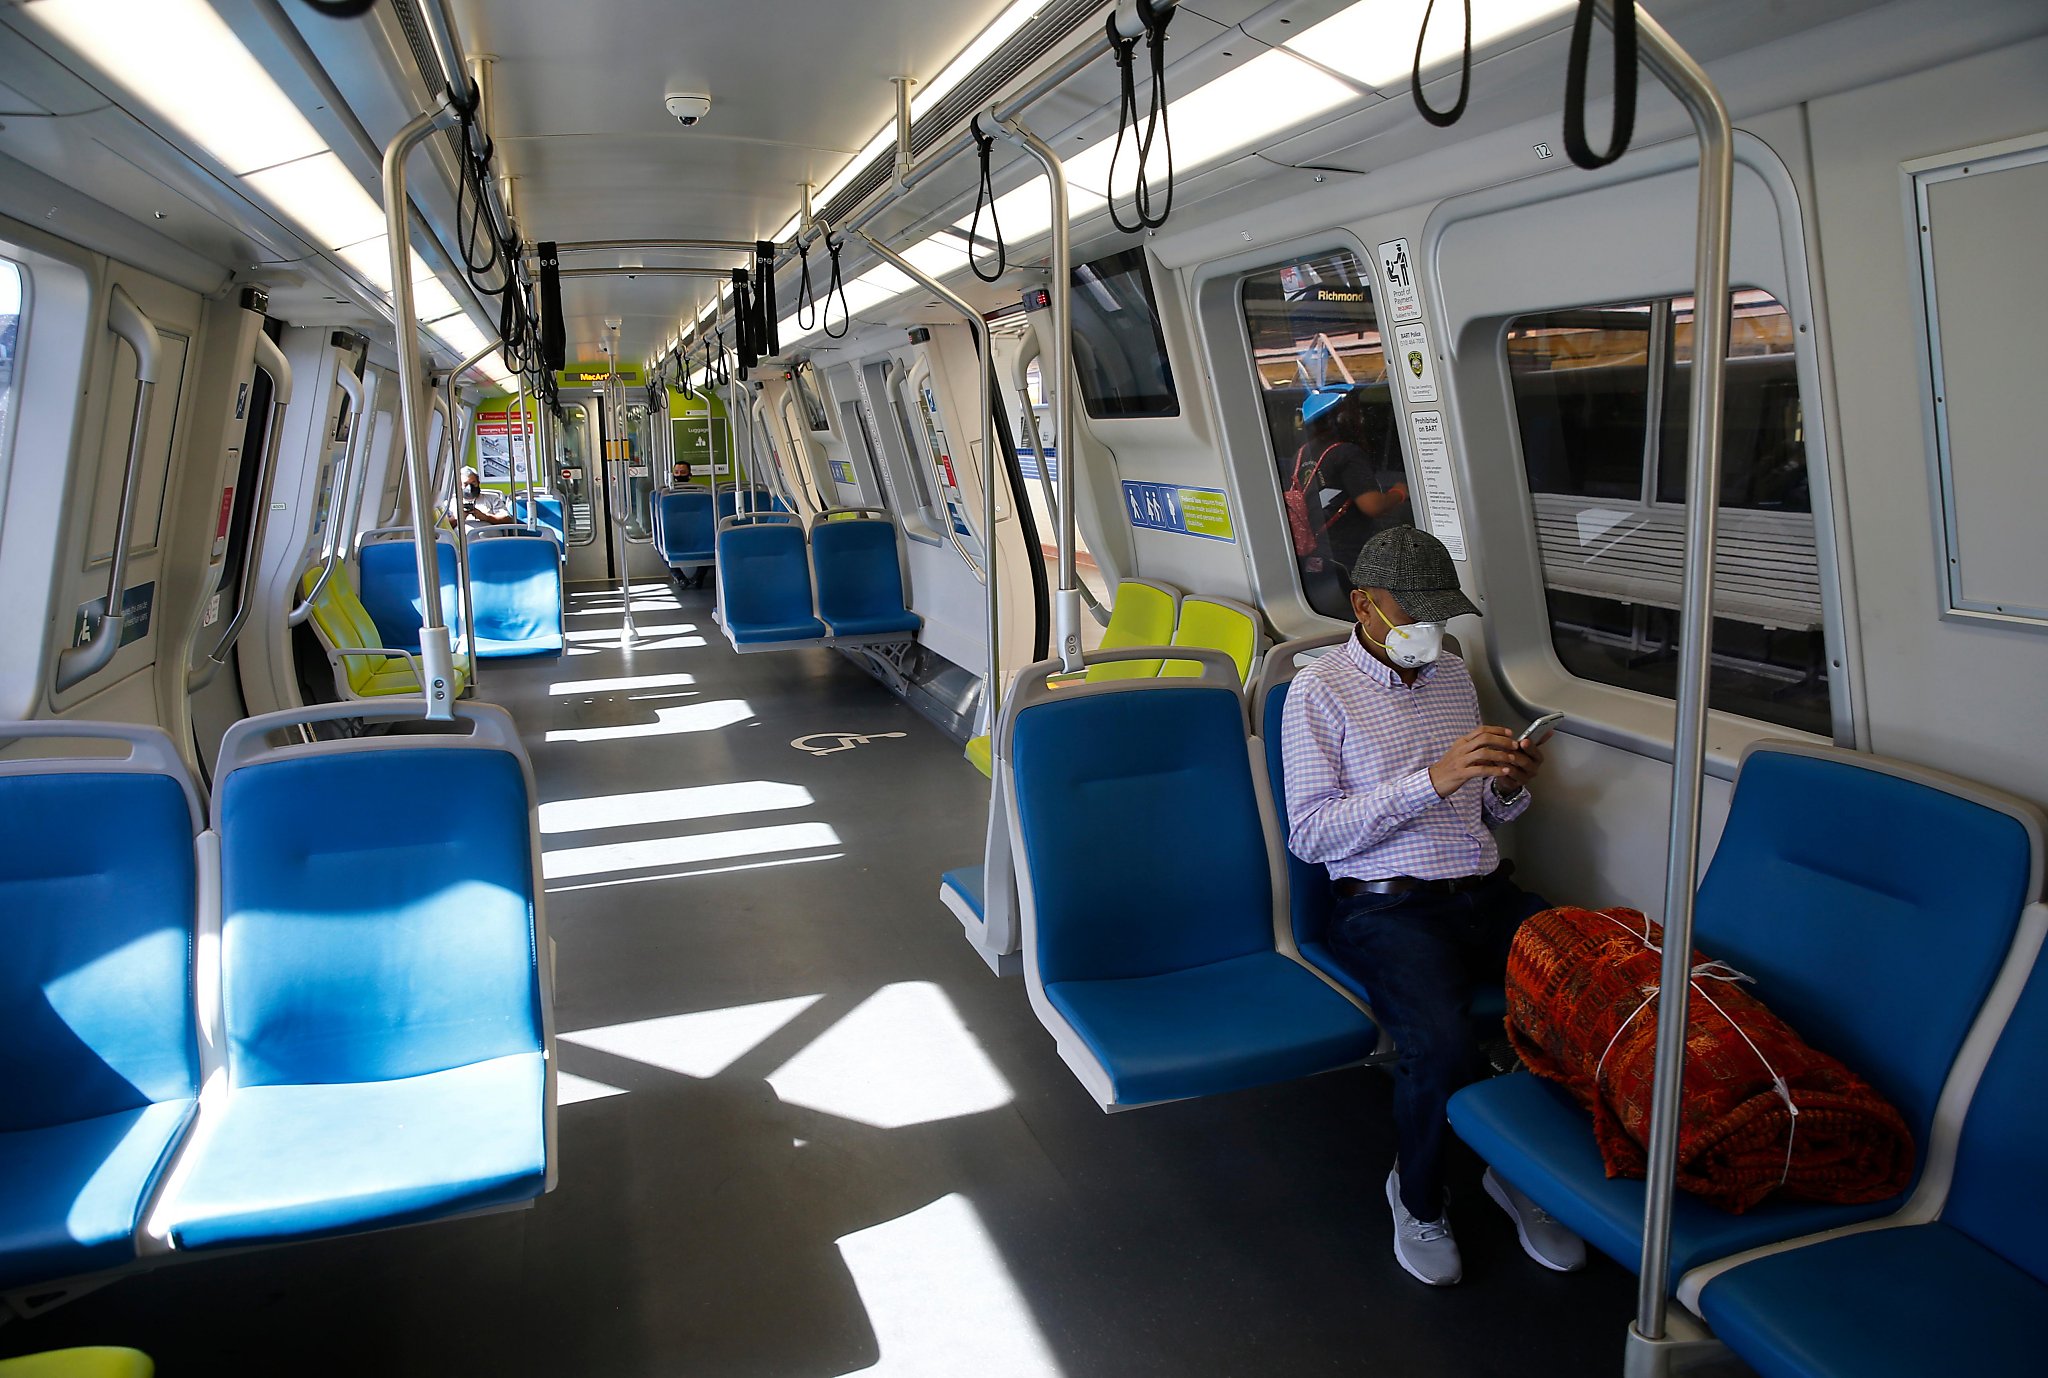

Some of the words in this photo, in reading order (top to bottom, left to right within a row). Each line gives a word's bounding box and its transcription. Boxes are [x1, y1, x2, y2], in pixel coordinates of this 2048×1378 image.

[1536, 145, 1551, 157] 12
[1318, 290, 1364, 302] Richmond
[1393, 288, 1405, 297] Proof
[1394, 296, 1414, 305] Payment
